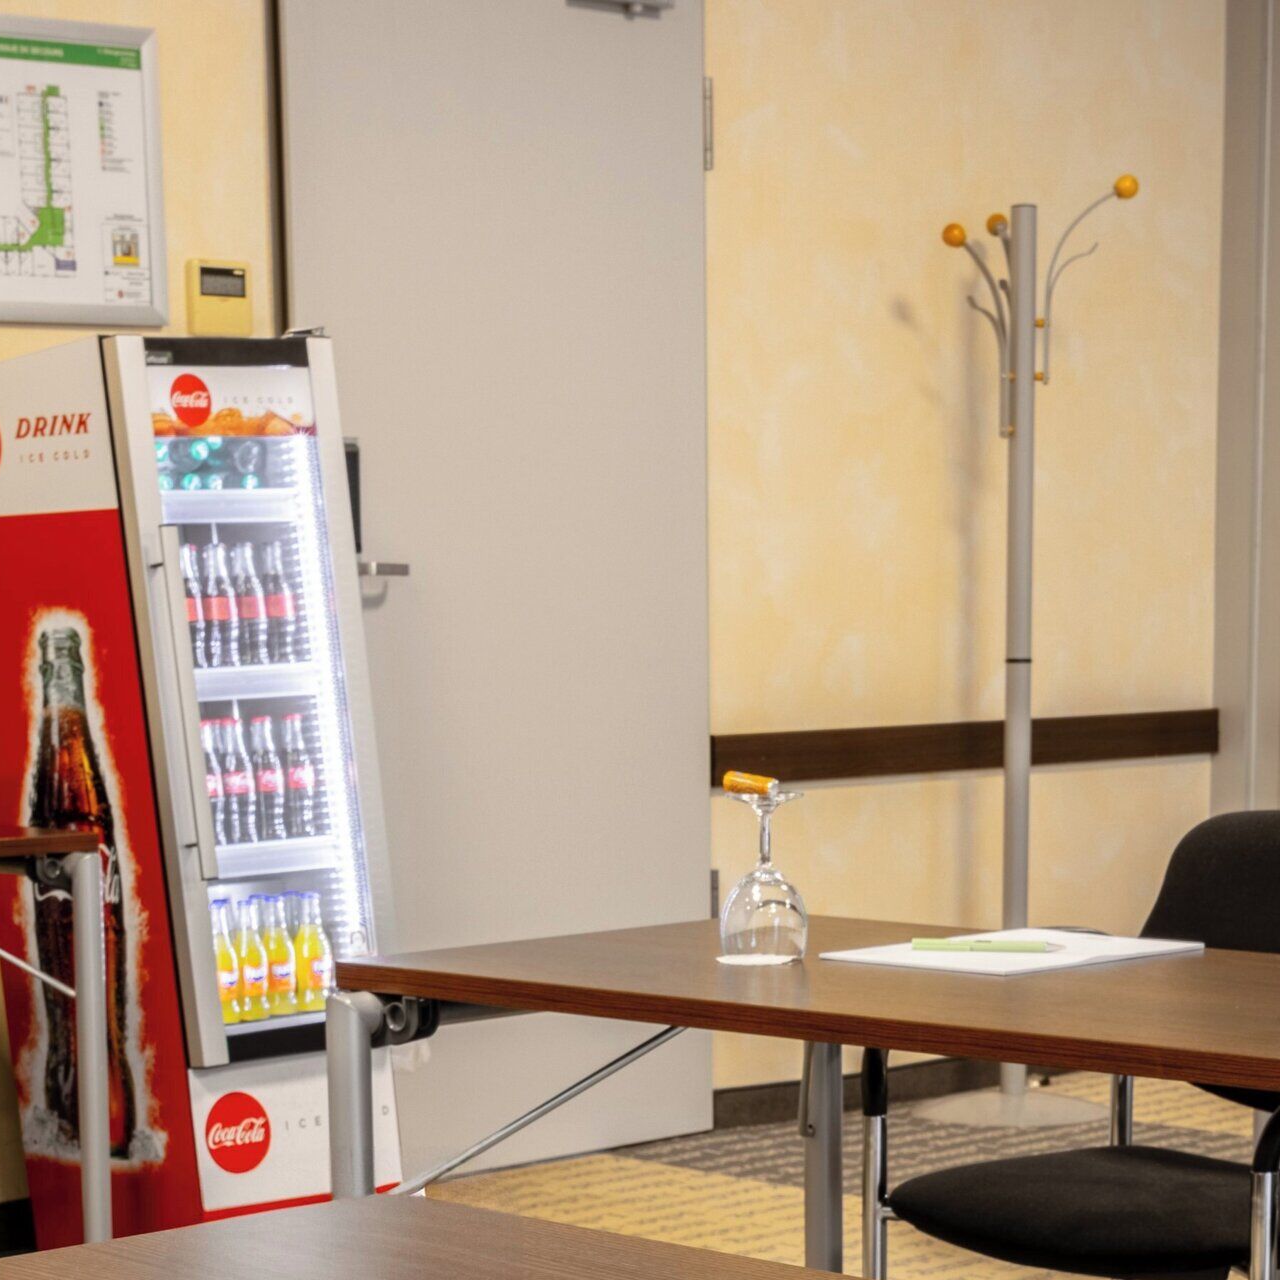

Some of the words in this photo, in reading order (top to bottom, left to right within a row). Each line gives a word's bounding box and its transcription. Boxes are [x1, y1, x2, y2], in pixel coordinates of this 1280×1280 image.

[223, 396, 248, 405] ICE
[257, 396, 294, 405] COLD
[15, 413, 91, 439] DRINK
[19, 453, 45, 463] ICE
[53, 449, 90, 462] COLD
[284, 1115, 322, 1131] ICE
[208, 1116, 267, 1149] Coca-Cola
